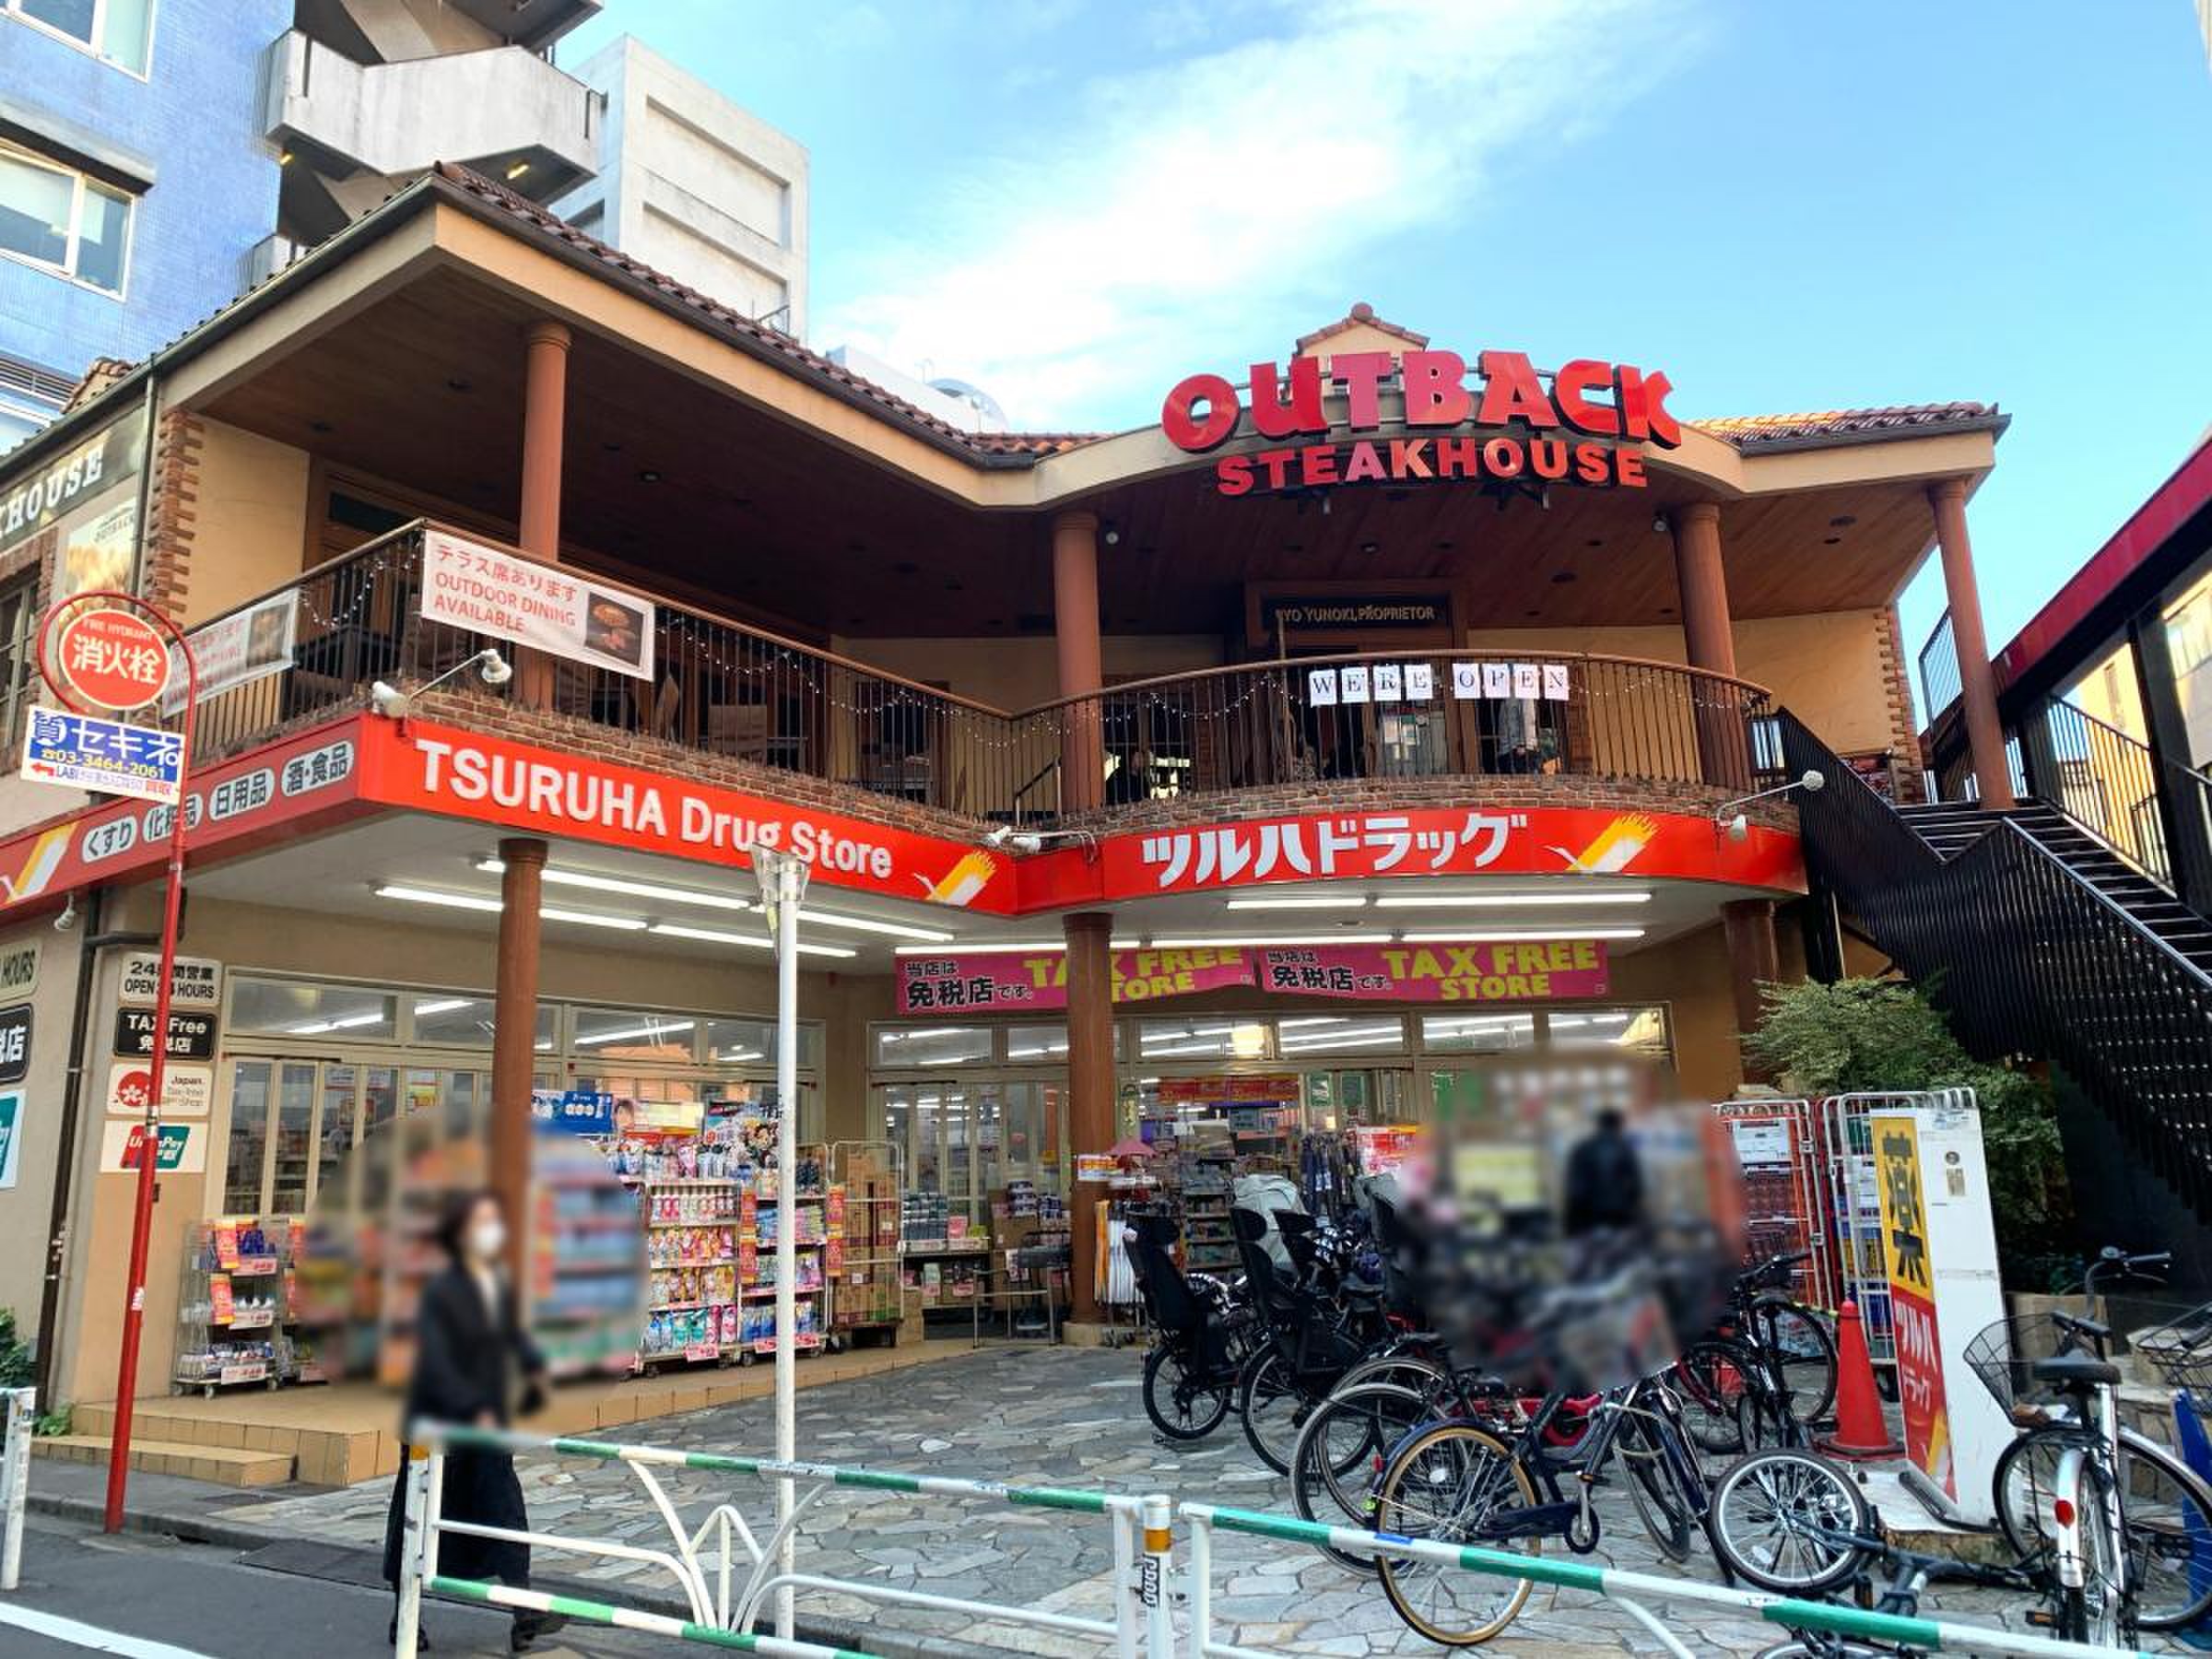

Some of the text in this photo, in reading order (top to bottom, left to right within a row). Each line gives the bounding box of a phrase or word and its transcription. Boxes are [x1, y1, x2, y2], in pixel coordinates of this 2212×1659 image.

[1160, 349, 1681, 453] OUTBACK
[1217, 436, 1648, 497] STEAKHOUSE
[436, 545, 577, 602] テラス席あります
[433, 594, 526, 632] AVAILABLE
[435, 571, 576, 627] OUTDOOR DINING
[72, 633, 161, 684] 消火栓
[1459, 669, 1565, 688] OPEN
[215, 772, 267, 817] 日用品
[416, 738, 892, 878] TSURUHA Drug Store
[87, 819, 132, 856] くすり
[1142, 812, 1528, 888] ツルハドラッグ
[130, 960, 214, 981] 24間営業
[906, 960, 958, 976] 当店は
[1136, 947, 1244, 977] FREE
[1382, 940, 1600, 980] TAX FREE
[124, 978, 156, 994] OPEN
[177, 982, 215, 999] HOURS
[1111, 972, 1195, 1004] TORE
[1441, 973, 1551, 1001] STORE
[138, 1034, 193, 1053] 免店
[169, 1017, 207, 1034] Free
[1894, 1299, 1938, 1374] ツルハ
